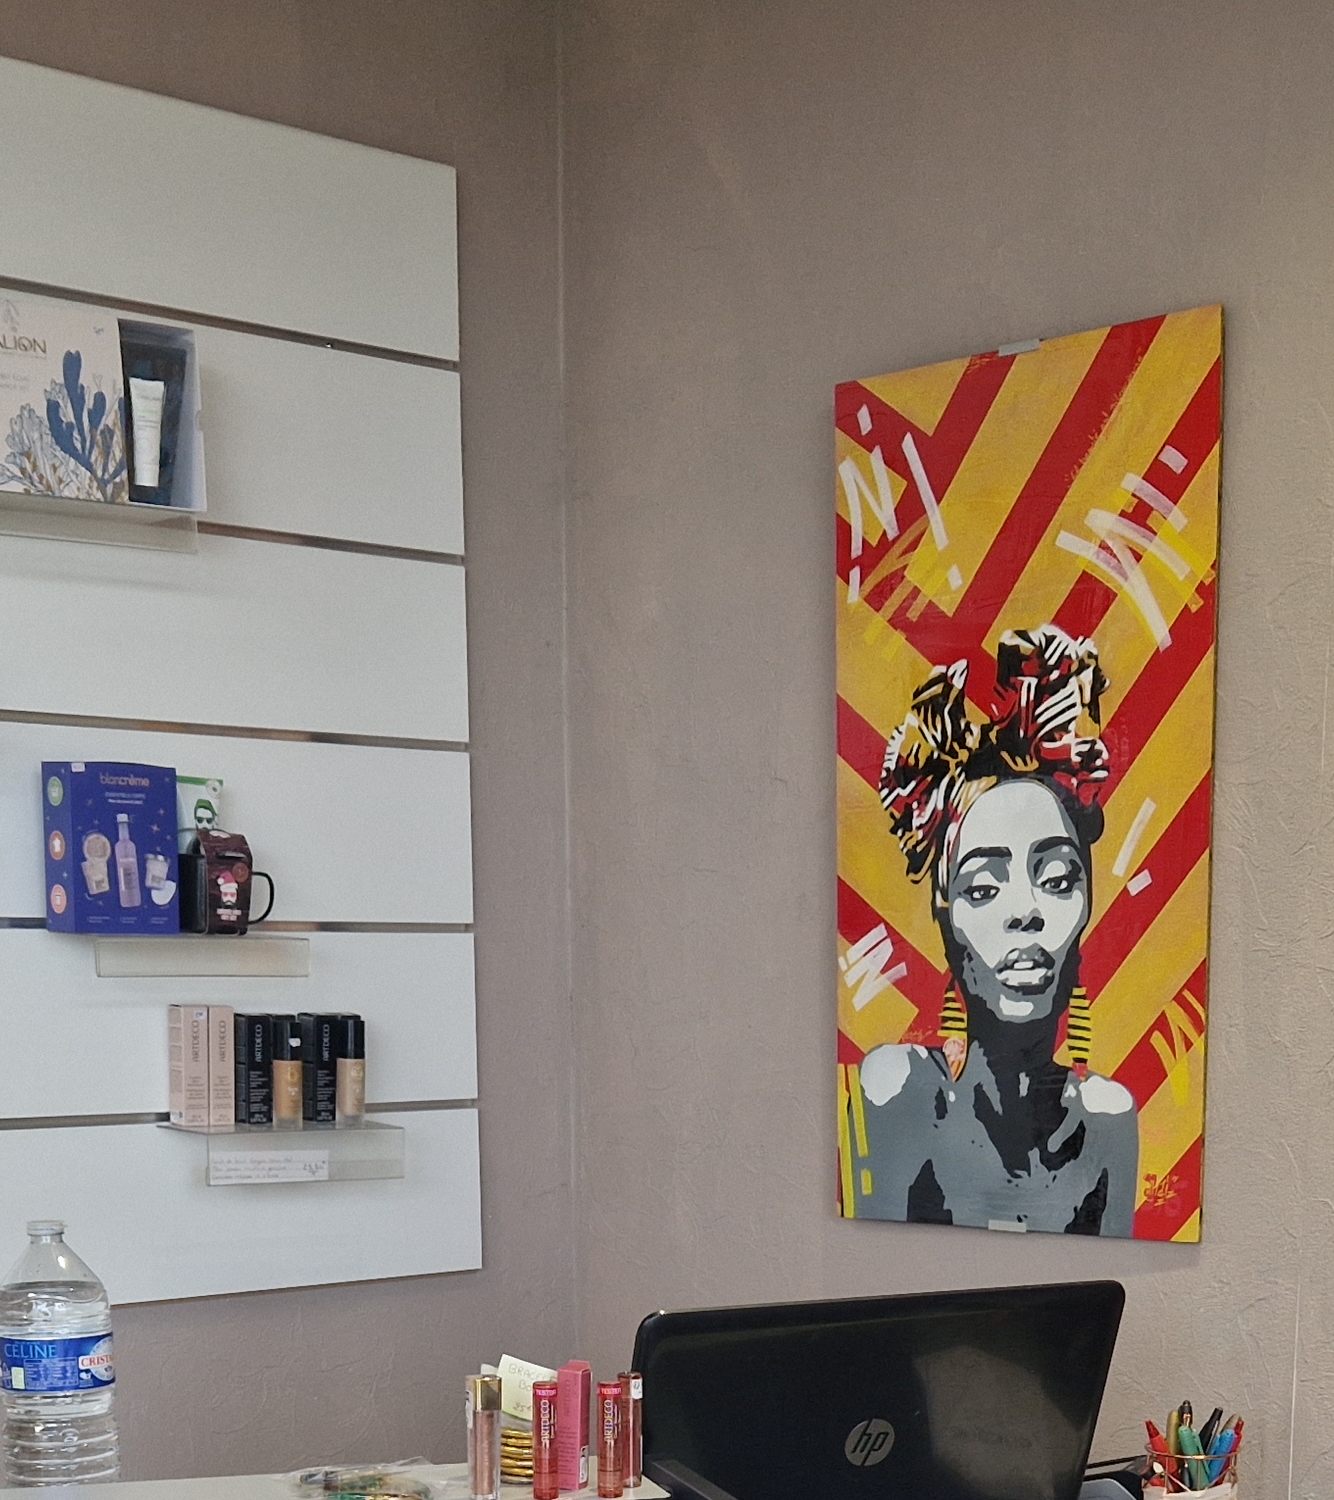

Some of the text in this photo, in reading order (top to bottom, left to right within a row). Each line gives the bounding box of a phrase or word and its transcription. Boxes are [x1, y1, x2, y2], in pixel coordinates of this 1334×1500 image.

[192, 1019, 200, 1063] ARTDECO
[218, 1019, 227, 1063] ARTDECO
[255, 1023, 263, 1063] ARTDECO
[323, 1023, 331, 1062] ARTDECO
[4, 1343, 58, 1358] CELINE
[853, 1423, 889, 1463] hp
